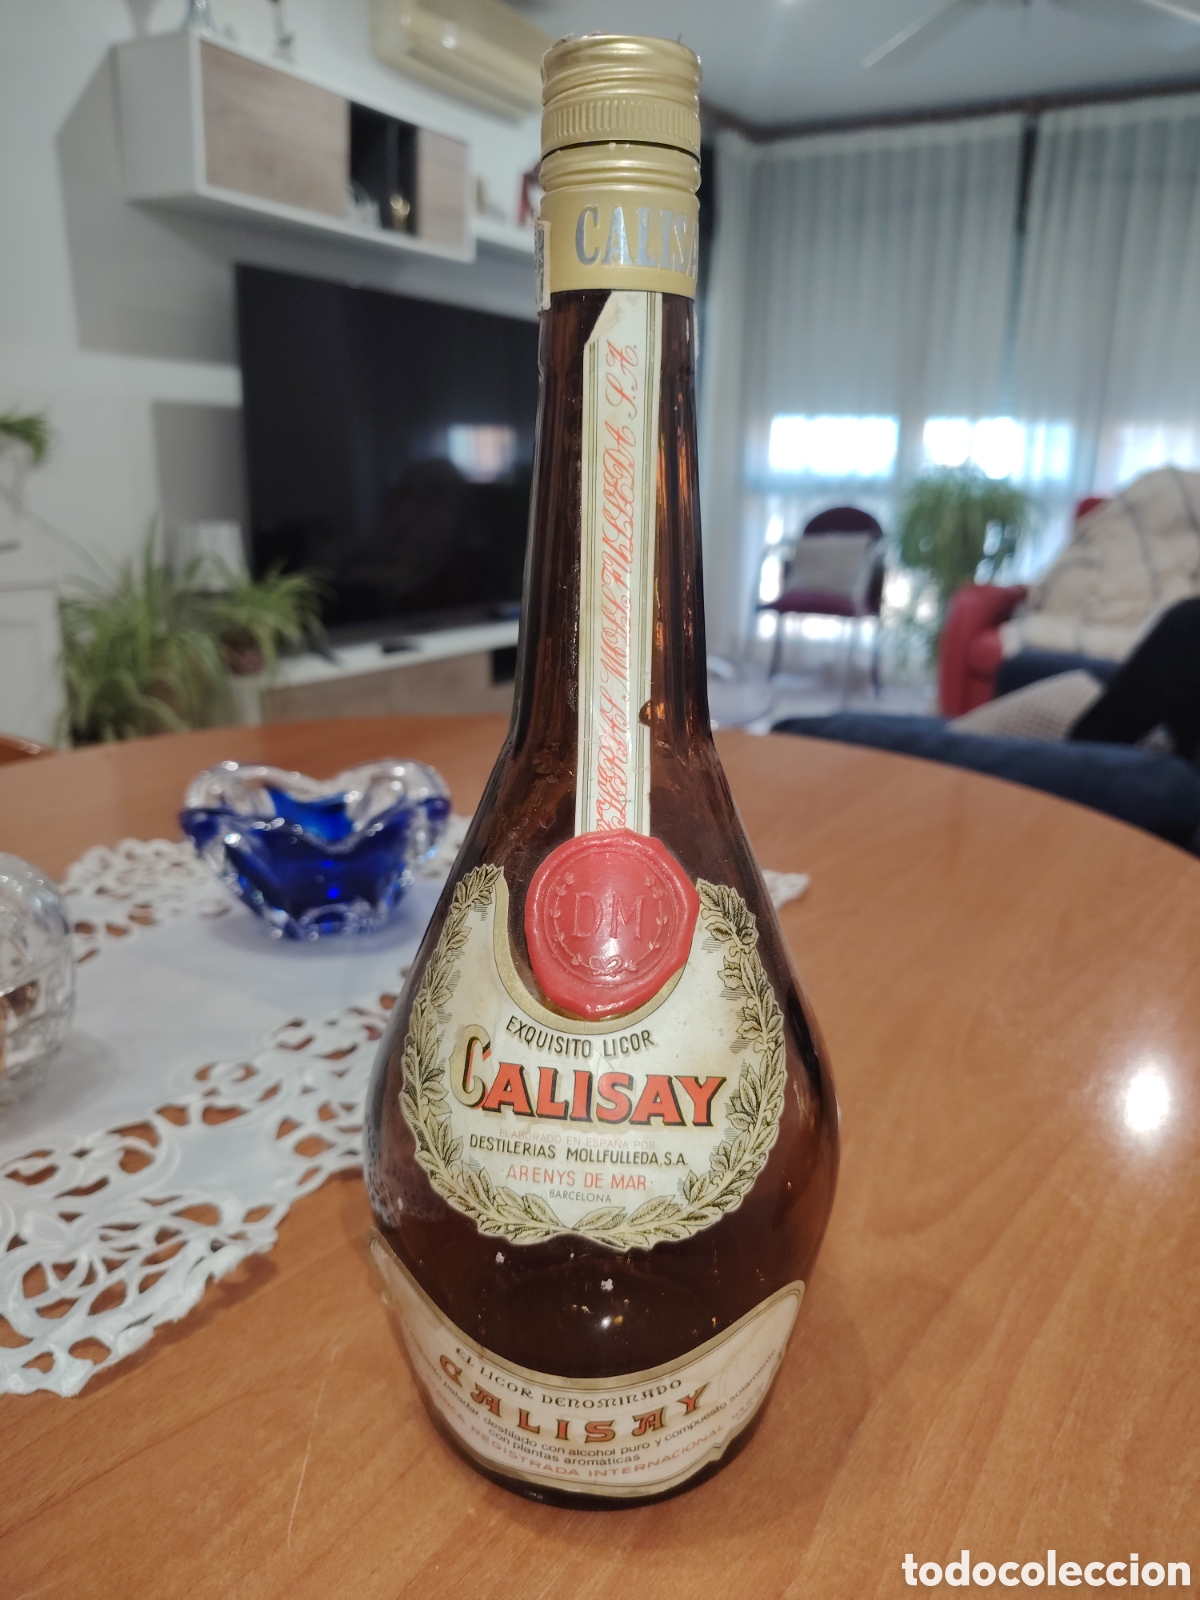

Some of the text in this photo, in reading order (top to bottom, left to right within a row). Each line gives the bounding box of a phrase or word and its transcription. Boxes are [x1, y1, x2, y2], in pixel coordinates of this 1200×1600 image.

[505, 1015, 655, 1058] EXQUISITO LICOR
[449, 1024, 727, 1127] CALISAY
[469, 1133, 556, 1160] DESTILERIAS
[499, 1128, 562, 1145] ELABORADO
[566, 1135, 581, 1146] EN
[585, 1137, 629, 1150] ESPAÑA
[505, 1164, 648, 1191] ARENYS DE MAR
[549, 1188, 612, 1204] BARCELONA
[439, 1354, 713, 1445] CALISAY
[455, 1347, 474, 1367] EL
[480, 1365, 534, 1400] LICOR
[541, 1379, 682, 1410] DENOMINADO
[483, 1416, 537, 1448] destilado
[541, 1442, 565, 1455] con
[568, 1446, 616, 1458] alcohol
[620, 1441, 650, 1456] puro
[654, 1438, 662, 1448] y
[664, 1402, 727, 1442] compuesto
[728, 1348, 777, 1403] solamente
[470, 1424, 580, 1477] REGISTRADA
[588, 1424, 725, 1478] INTERNACIONAL
[488, 1426, 641, 1467] con plantas aromáticas
